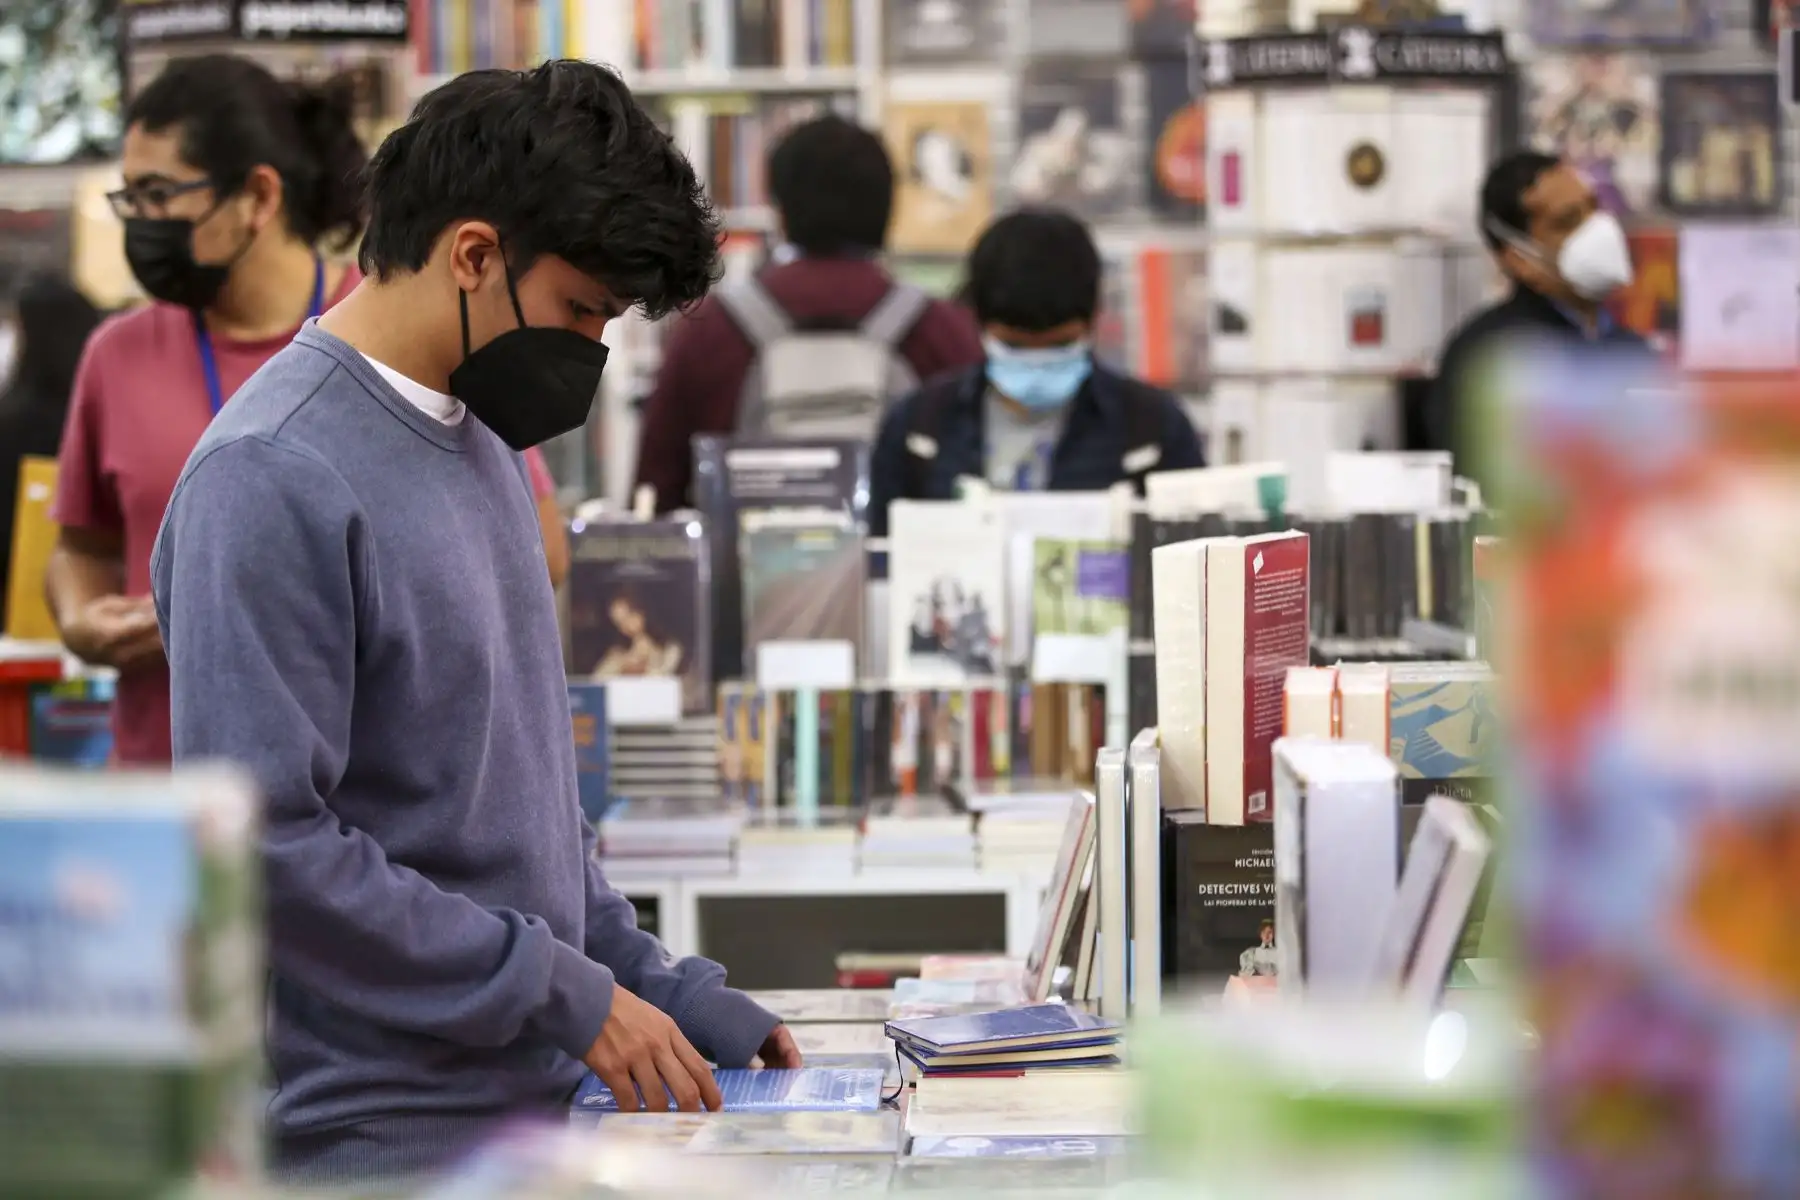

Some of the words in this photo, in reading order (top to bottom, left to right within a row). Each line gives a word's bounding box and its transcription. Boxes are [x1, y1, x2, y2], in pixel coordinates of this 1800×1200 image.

[1234, 858, 1276, 868] MICHAEL
[1198, 883, 1261, 895] DETECTIVES
[1263, 883, 1277, 895] VI
[1248, 899, 1257, 907] DE
